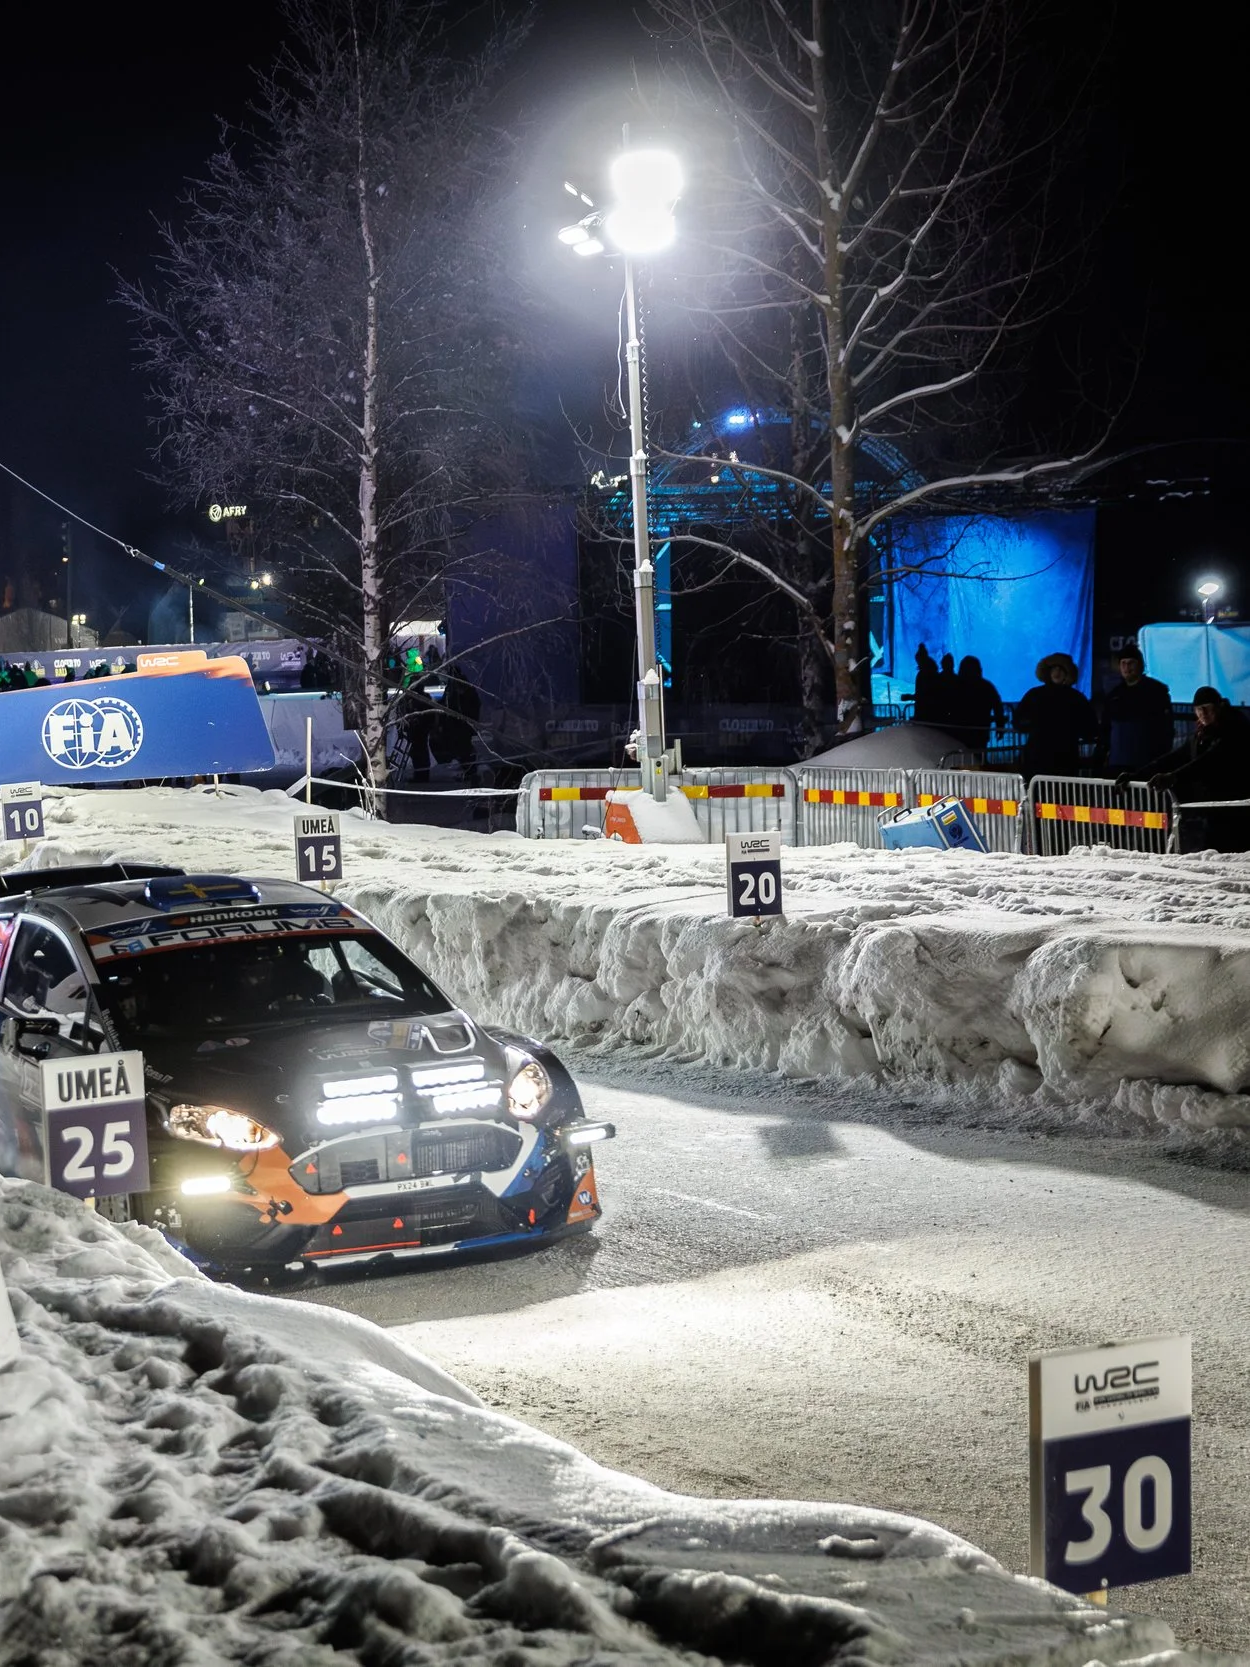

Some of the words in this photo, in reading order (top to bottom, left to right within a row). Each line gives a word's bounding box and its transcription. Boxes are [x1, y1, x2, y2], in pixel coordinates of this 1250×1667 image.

[222, 505, 247, 518] AFRY
[140, 656, 180, 668] WRC
[10, 786, 33, 795] WRC
[9, 808, 40, 833] 10
[302, 815, 335, 835] UMEÅ
[740, 839, 770, 849] WRC
[303, 844, 337, 872] 15
[738, 871, 776, 906] 20
[57, 1059, 132, 1103] UMEÅ
[61, 1120, 135, 1183] 25
[1074, 1360, 1160, 1395] WRC
[1064, 1454, 1173, 1565] 30
